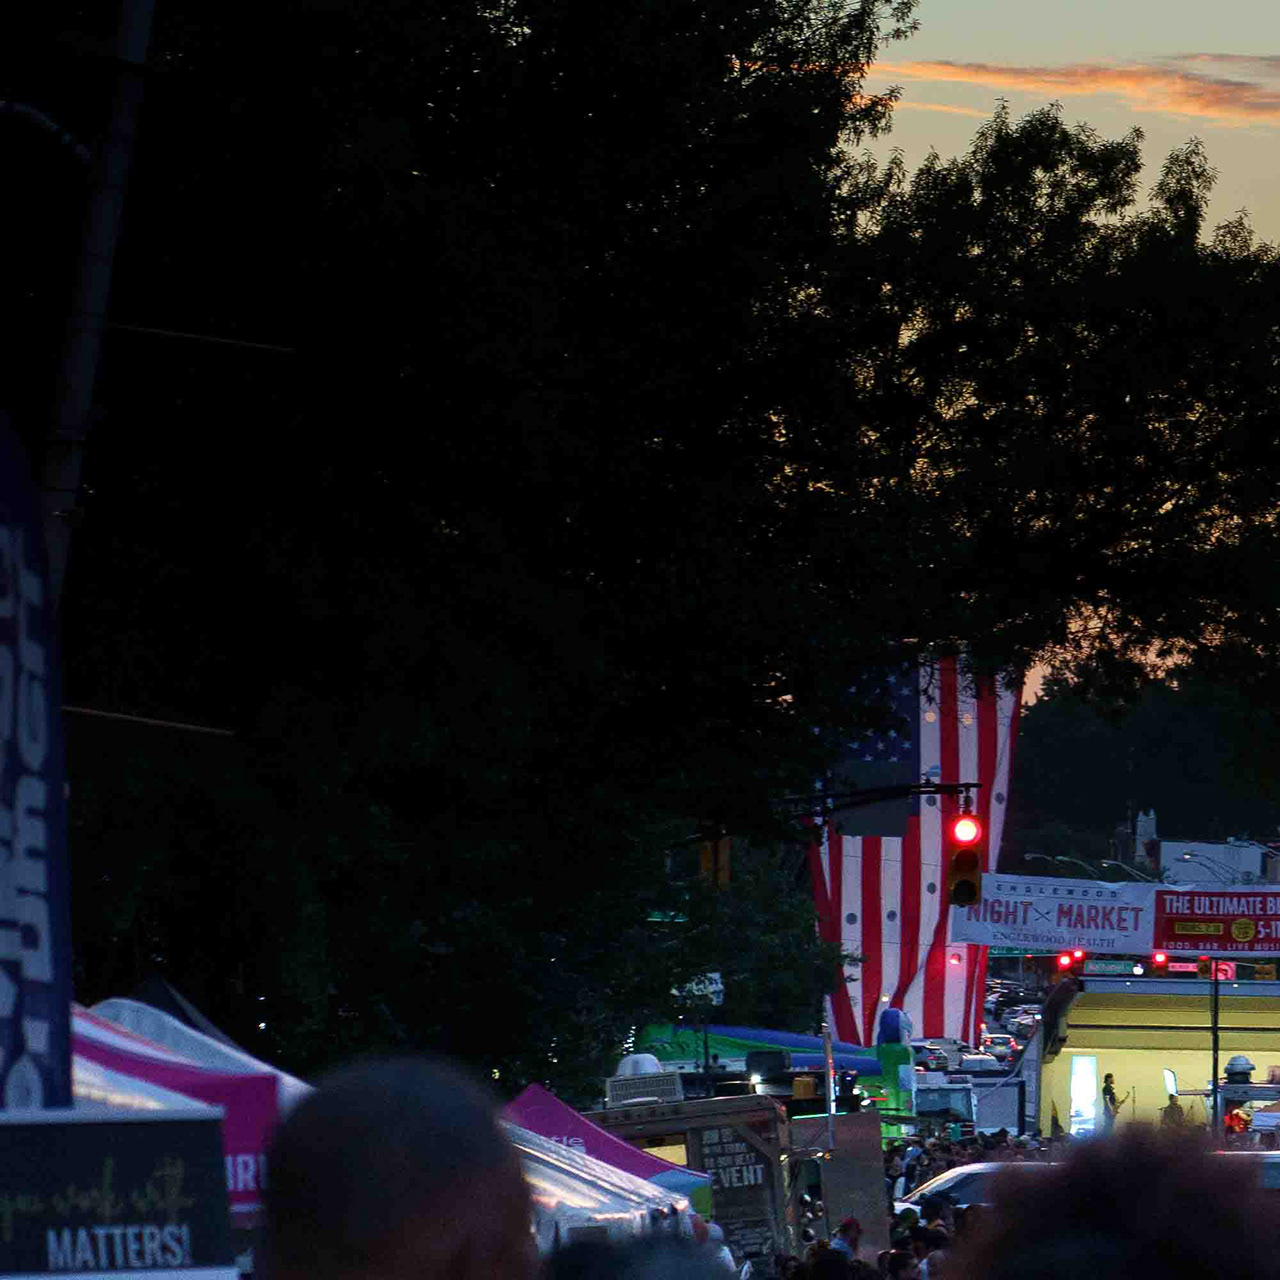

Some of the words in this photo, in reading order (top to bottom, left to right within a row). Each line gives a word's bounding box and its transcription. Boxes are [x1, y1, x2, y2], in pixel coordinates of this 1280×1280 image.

[996, 884, 1118, 898] ENGLEWOOD
[1164, 894, 1191, 913] THE
[1194, 895, 1264, 915] ULTIMATE
[967, 899, 1034, 924] NIGHT
[1056, 903, 1144, 932] MARKET
[993, 930, 1066, 947] ENGLEWOOD
[1068, 936, 1116, 949] HEALTH
[1227, 942, 1250, 951] LIVE
[47, 1223, 193, 1270] MATTERS!
